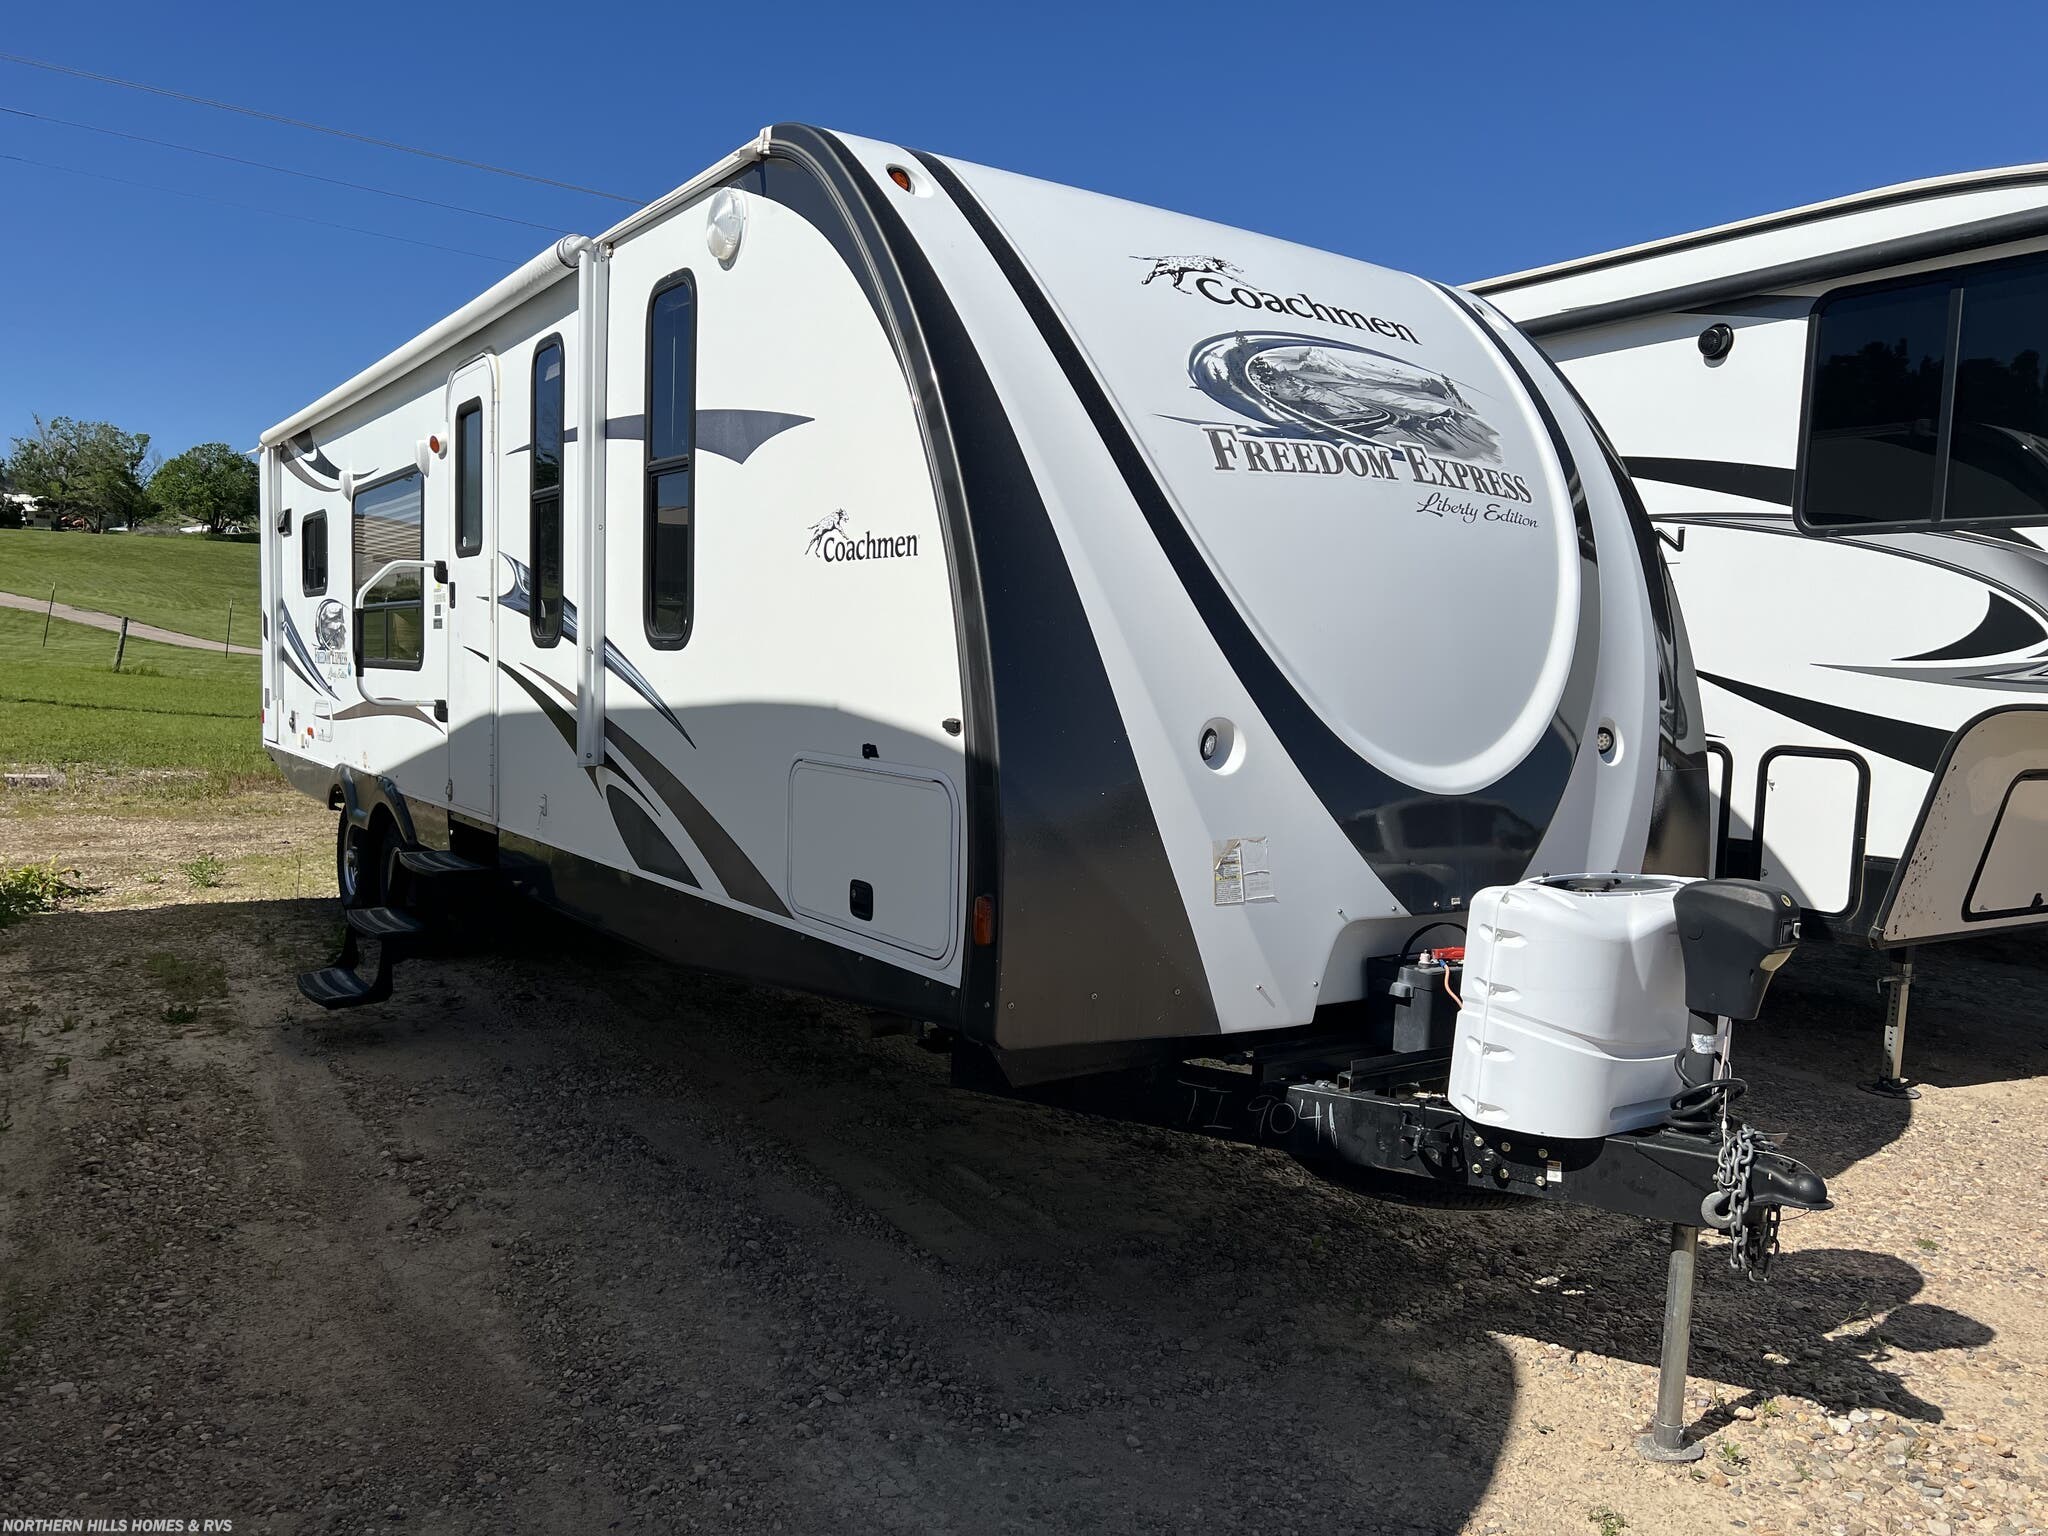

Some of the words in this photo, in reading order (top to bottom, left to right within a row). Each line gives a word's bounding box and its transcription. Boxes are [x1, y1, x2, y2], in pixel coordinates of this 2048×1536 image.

[1195, 277, 1423, 345] Coachmen
[1416, 492, 1478, 523] Liberty
[1484, 503, 1538, 528] Edition
[823, 530, 918, 562] Coachmen
